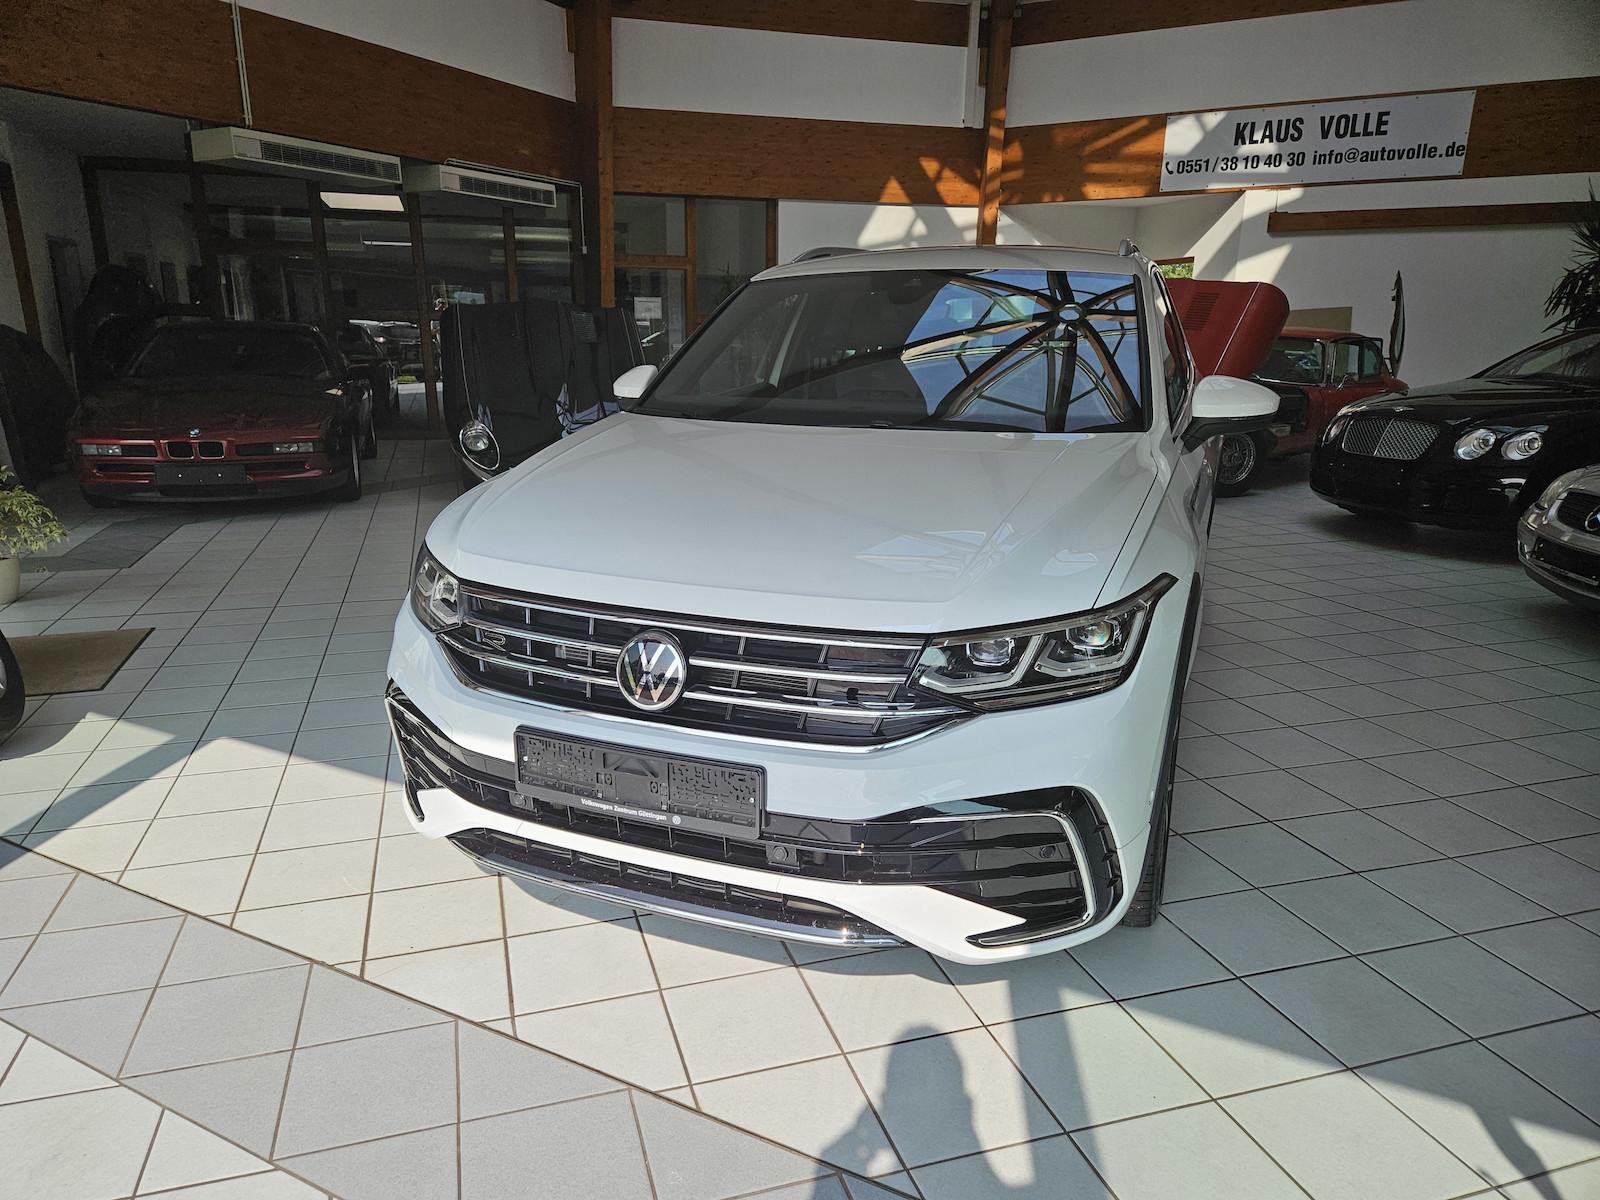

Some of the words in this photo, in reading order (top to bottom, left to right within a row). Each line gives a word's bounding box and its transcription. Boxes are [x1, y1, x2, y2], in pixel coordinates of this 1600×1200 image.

[1234, 117, 1304, 146] KLAUS
[1320, 110, 1391, 140] VOLLE
[1244, 154, 1260, 170] 10
[1264, 153, 1283, 168] 40
[1287, 151, 1306, 167] 30
[1312, 141, 1466, 165] info@autovolle.de
[581, 798, 613, 811] Volkswagen
[613, 805, 638, 815] Zentrum
[638, 810, 667, 821] Göttingen
